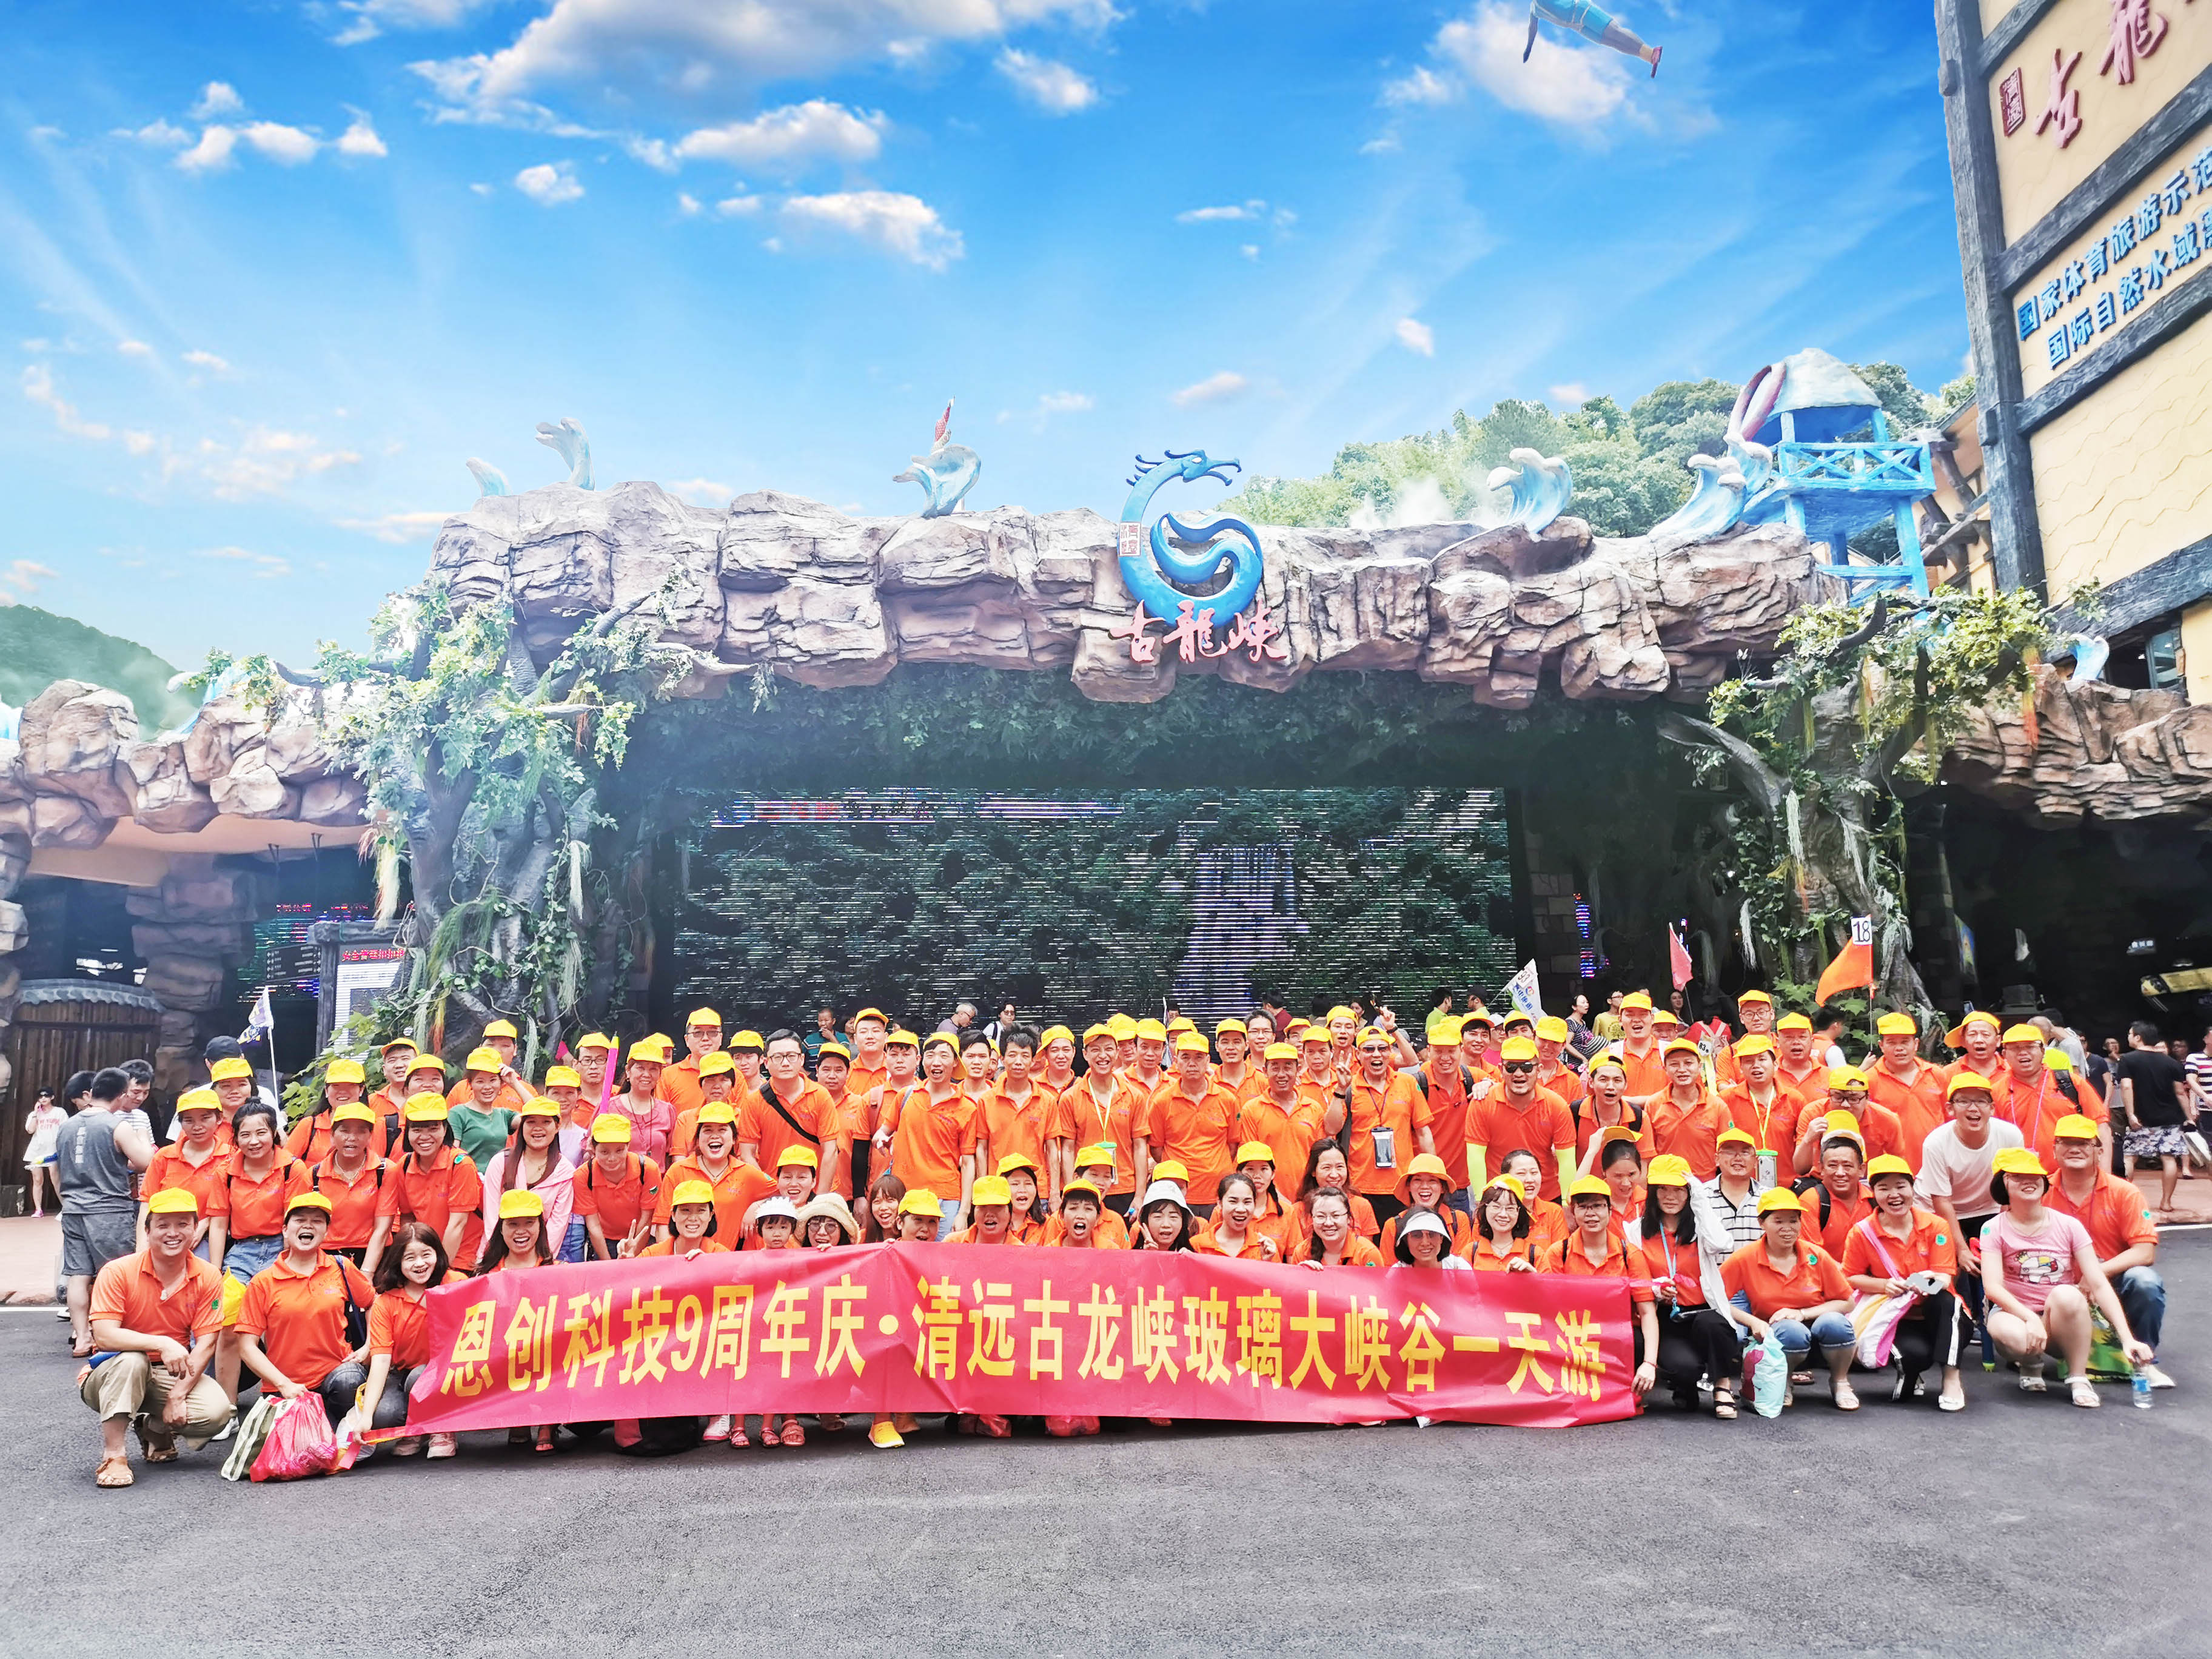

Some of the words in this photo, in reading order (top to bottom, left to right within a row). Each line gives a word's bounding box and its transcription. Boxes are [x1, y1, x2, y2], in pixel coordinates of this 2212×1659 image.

[2033, 0, 2195, 149] 古龍
[1853, 920, 1871, 942] 18
[1518, 971, 1530, 983] 93
